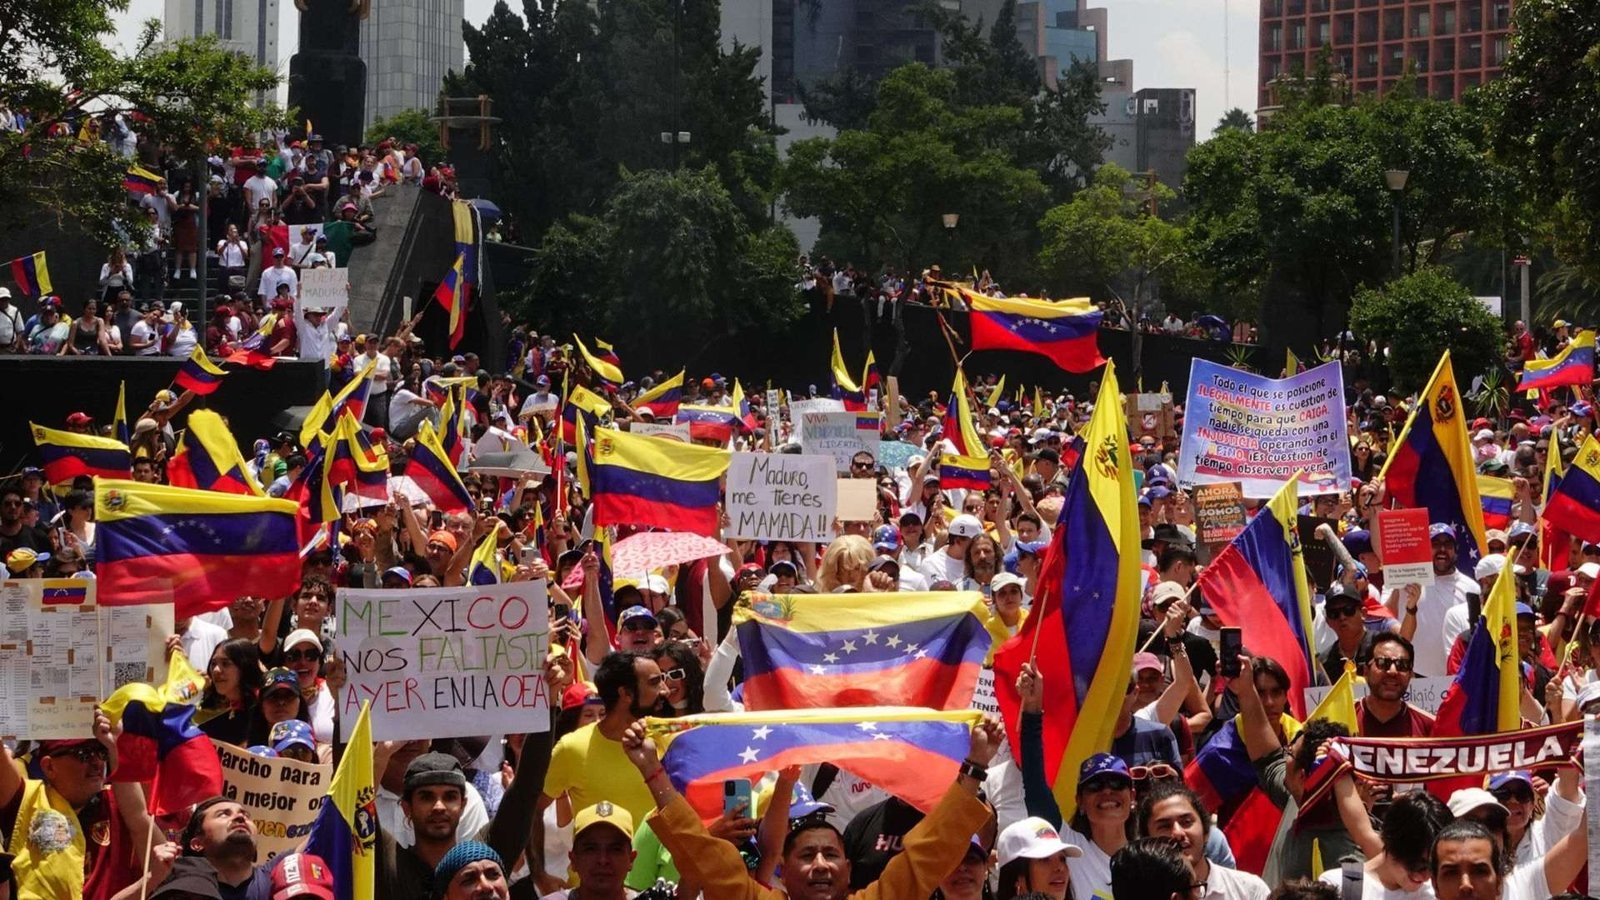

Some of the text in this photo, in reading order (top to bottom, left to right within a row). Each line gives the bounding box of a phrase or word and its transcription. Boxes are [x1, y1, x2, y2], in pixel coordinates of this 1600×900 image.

[305, 288, 346, 297] MADURO
[1197, 384, 1272, 412] ILEGALMENTE
[1274, 402, 1286, 412] es
[1327, 387, 1338, 399] de
[1213, 375, 1326, 402] Todo el que se posicione
[806, 414, 828, 424] VIVA
[1208, 402, 1244, 421] tiempo
[1246, 413, 1272, 426] para
[1276, 414, 1297, 428] que
[1196, 426, 1338, 453] INJUSTICIA operando en el
[1208, 417, 1330, 441] nadie se queda con una
[1316, 448, 1328, 460] de
[749, 456, 808, 490] Maduro,
[1238, 460, 1289, 475] observen
[732, 488, 822, 508] me tienes
[1196, 487, 1238, 496] AHORA
[1199, 506, 1240, 516] SOMOS
[960, 526, 965, 534] 3
[343, 596, 529, 637] MEXICO
[343, 632, 549, 674] NOS FALTASTE
[345, 677, 426, 714] AYER
[280, 764, 321, 786] para
[222, 780, 238, 799] la
[243, 790, 296, 811] mejor
